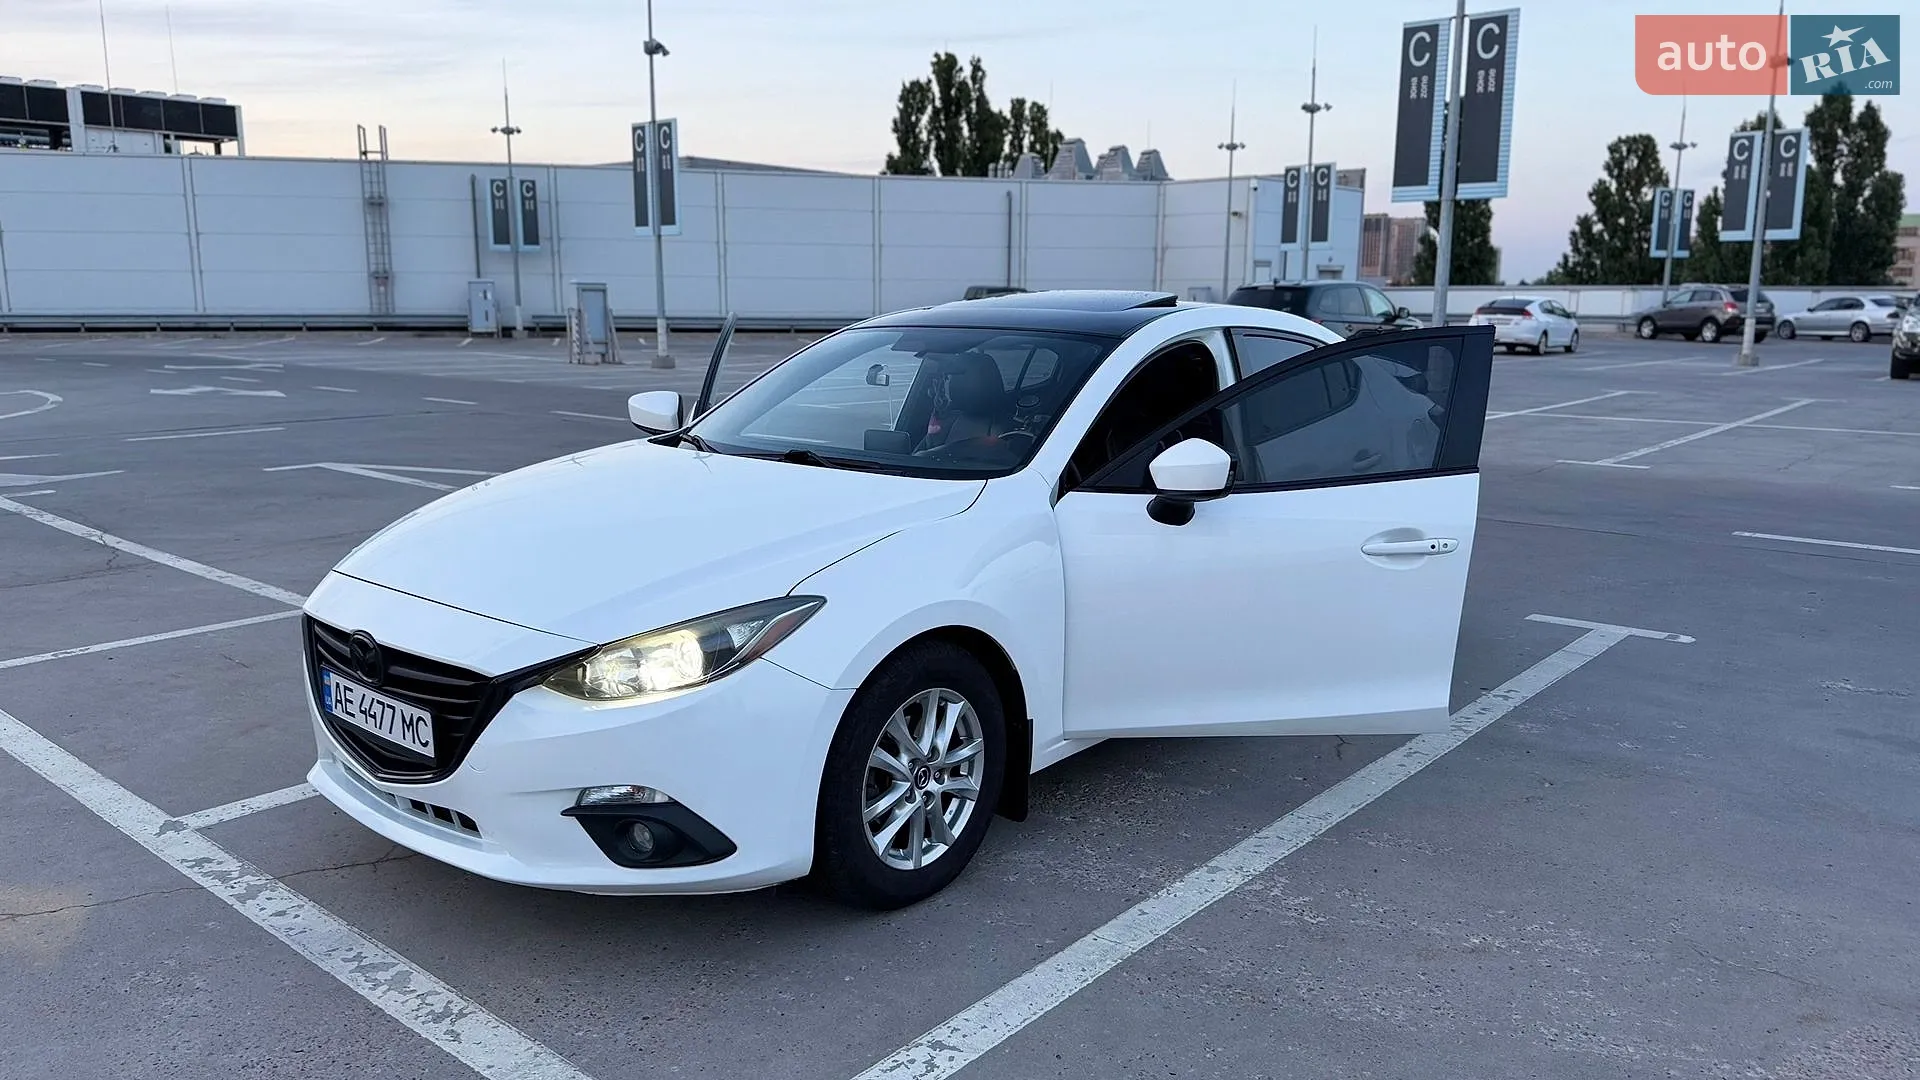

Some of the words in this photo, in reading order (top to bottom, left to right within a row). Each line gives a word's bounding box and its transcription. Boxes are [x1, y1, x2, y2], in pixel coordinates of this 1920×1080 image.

[1409, 31, 1431, 67] C
[1477, 23, 1500, 59] C
[634, 130, 644, 152] C
[660, 126, 670, 149] C
[1780, 135, 1797, 158] C
[1733, 138, 1749, 160] C
[1287, 171, 1297, 187] C
[1317, 168, 1327, 186] C
[493, 181, 504, 197] C
[522, 182, 533, 197] C
[1661, 192, 1671, 206] C
[1684, 193, 1692, 207] C
[335, 681, 356, 718] AE
[359, 693, 396, 735] 4477
[400, 708, 430, 748] MC
